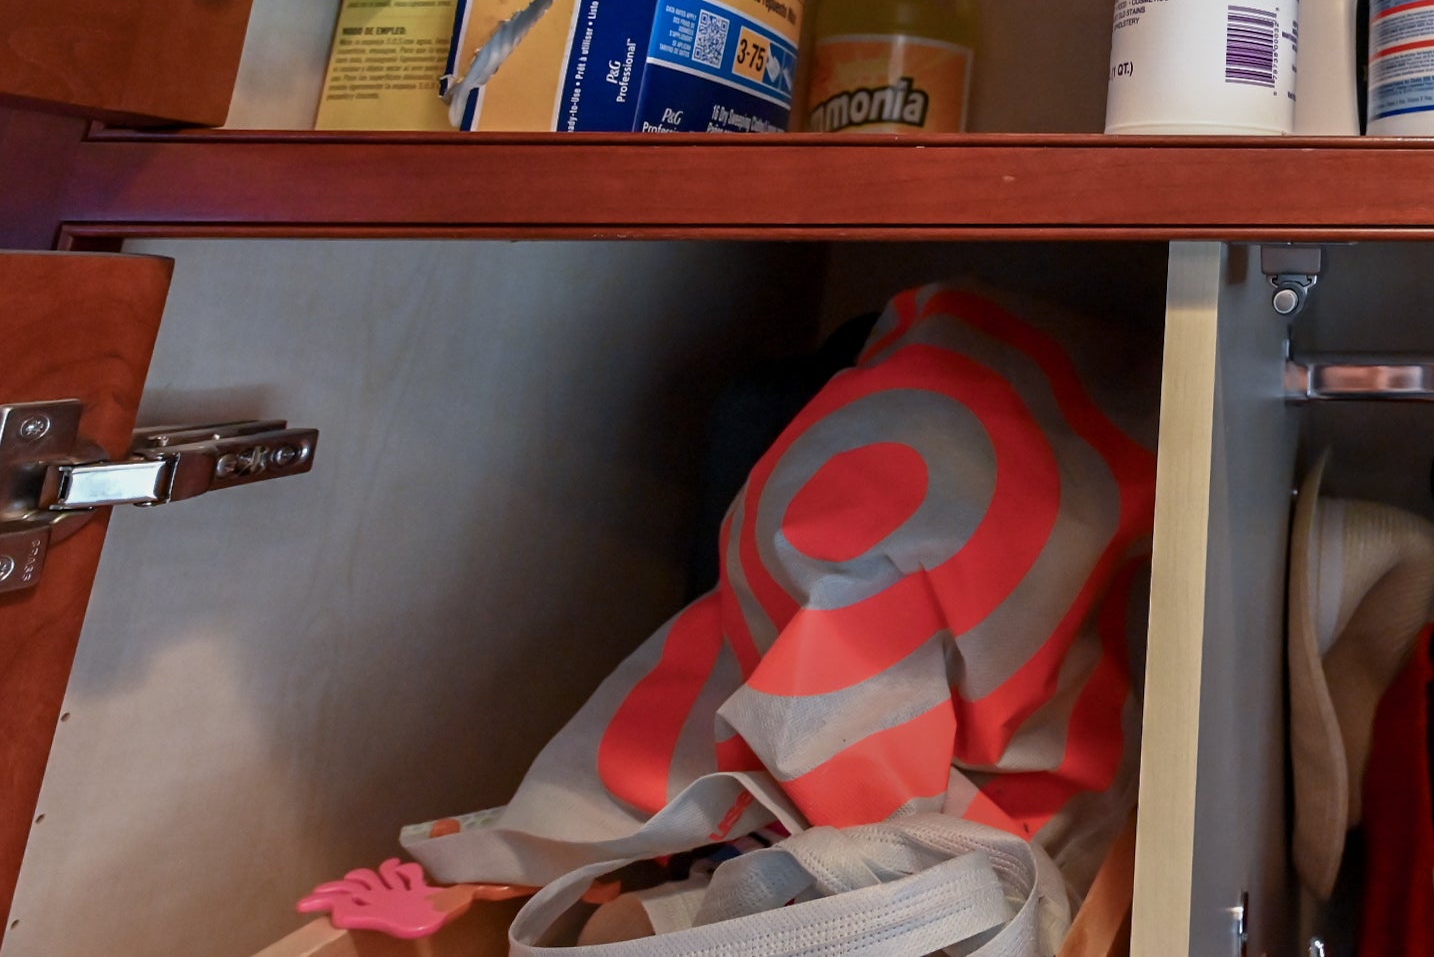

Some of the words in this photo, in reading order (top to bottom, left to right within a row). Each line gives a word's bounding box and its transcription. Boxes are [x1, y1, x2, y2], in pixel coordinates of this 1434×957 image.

[588, 0, 600, 20] Listo
[1126, 6, 1146, 17] STAINS
[580, 27, 593, 57] utiliser
[736, 39, 766, 72] 3-75
[575, 60, 587, 80] Prêt
[606, 59, 621, 84] P&G
[1117, 61, 1134, 77] QT.)
[661, 107, 684, 125] P&G
